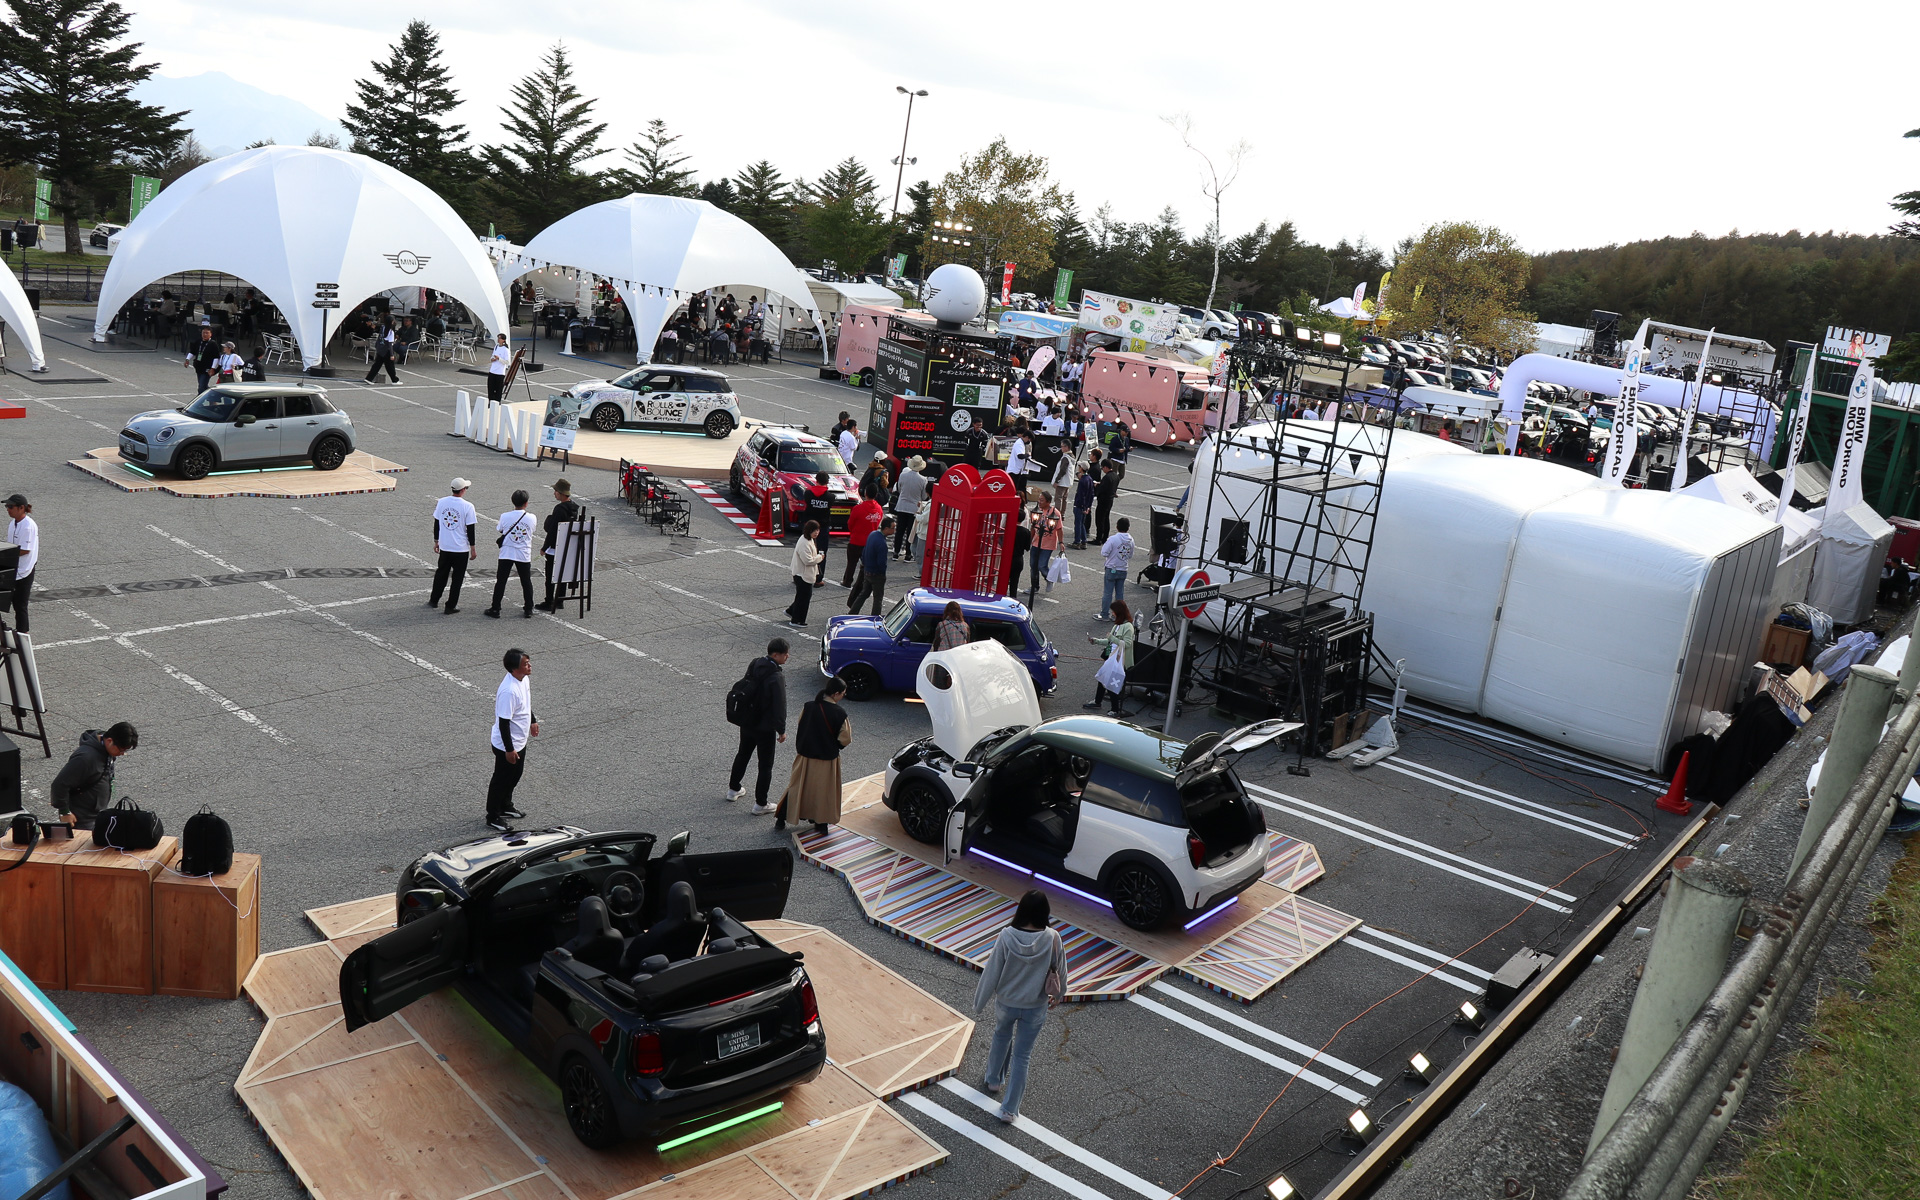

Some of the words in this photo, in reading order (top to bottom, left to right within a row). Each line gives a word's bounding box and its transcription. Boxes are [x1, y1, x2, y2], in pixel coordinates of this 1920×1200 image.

[144, 182, 152, 199] MINI
[400, 258, 417, 266] MINI
[1823, 346, 1847, 357] MINI
[1626, 386, 1637, 428] BMW
[646, 408, 683, 418] BOUNCE
[454, 389, 540, 459] MINI
[900, 421, 935, 431] 00:00:00
[1854, 407, 1866, 443] BMW
[1611, 386, 1627, 478] MOTORRAD
[897, 439, 933, 449] 00:00:00
[1839, 406, 1856, 489] MOTORRAD
[772, 503, 780, 512] 34
[810, 499, 829, 507] SYCG
[1190, 591, 1208, 600] UNITED
[731, 1029, 745, 1038] MINI
[728, 1034, 750, 1046] UNITED
